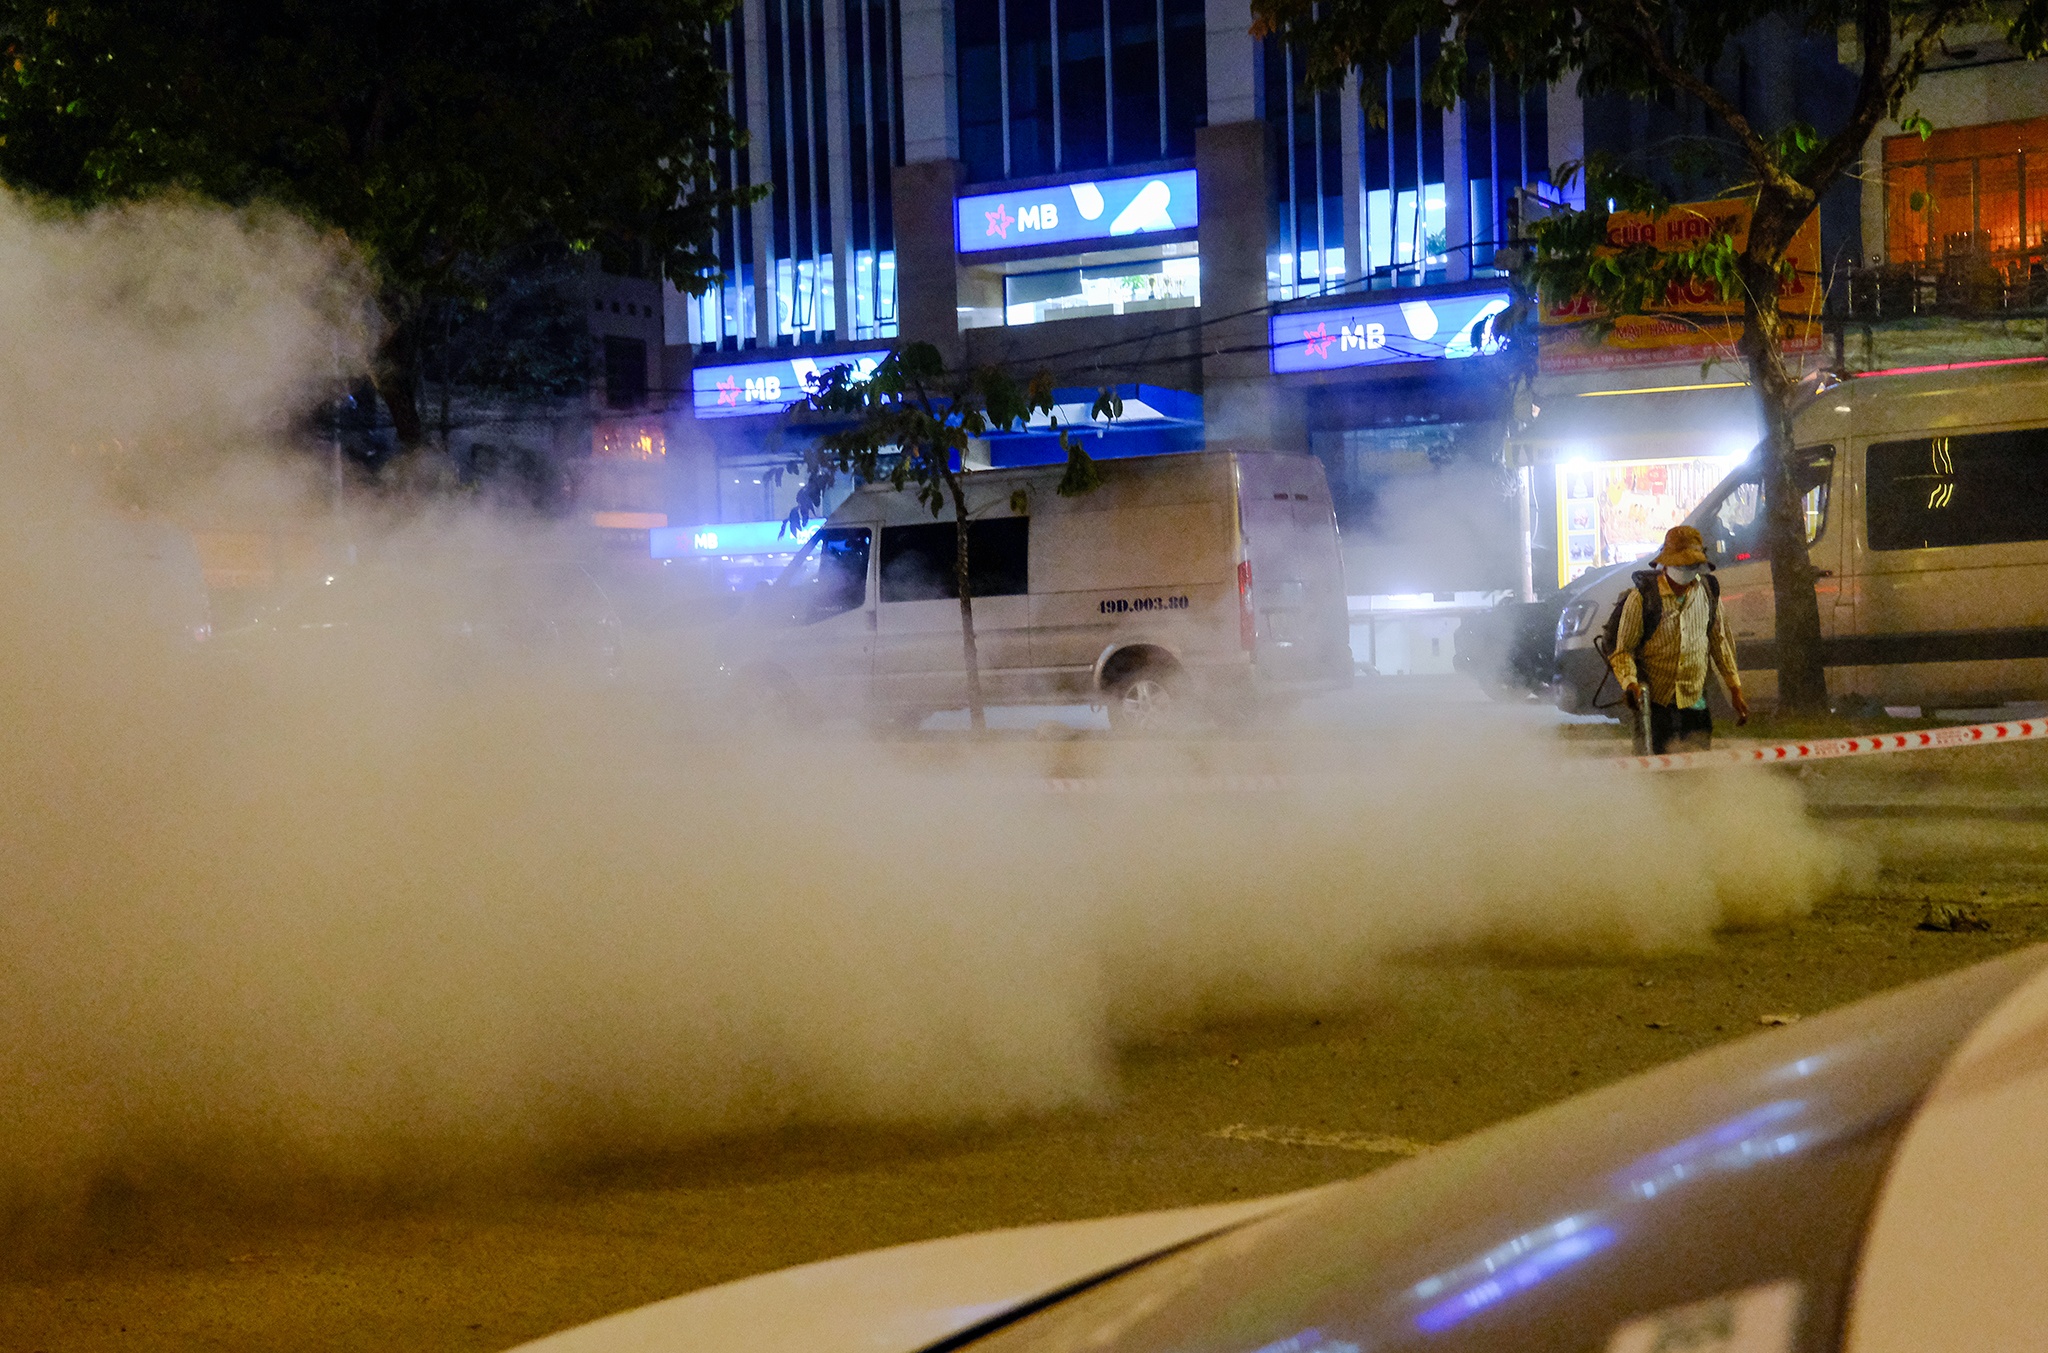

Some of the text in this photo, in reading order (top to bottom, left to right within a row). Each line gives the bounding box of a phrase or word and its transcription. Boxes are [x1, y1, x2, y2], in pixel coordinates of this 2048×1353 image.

[1018, 203, 1058, 232] MB
[1341, 322, 1386, 352] MB
[745, 375, 781, 402] MB
[694, 532, 718, 549] MB
[1097, 595, 1189, 613] 49D.003.80
